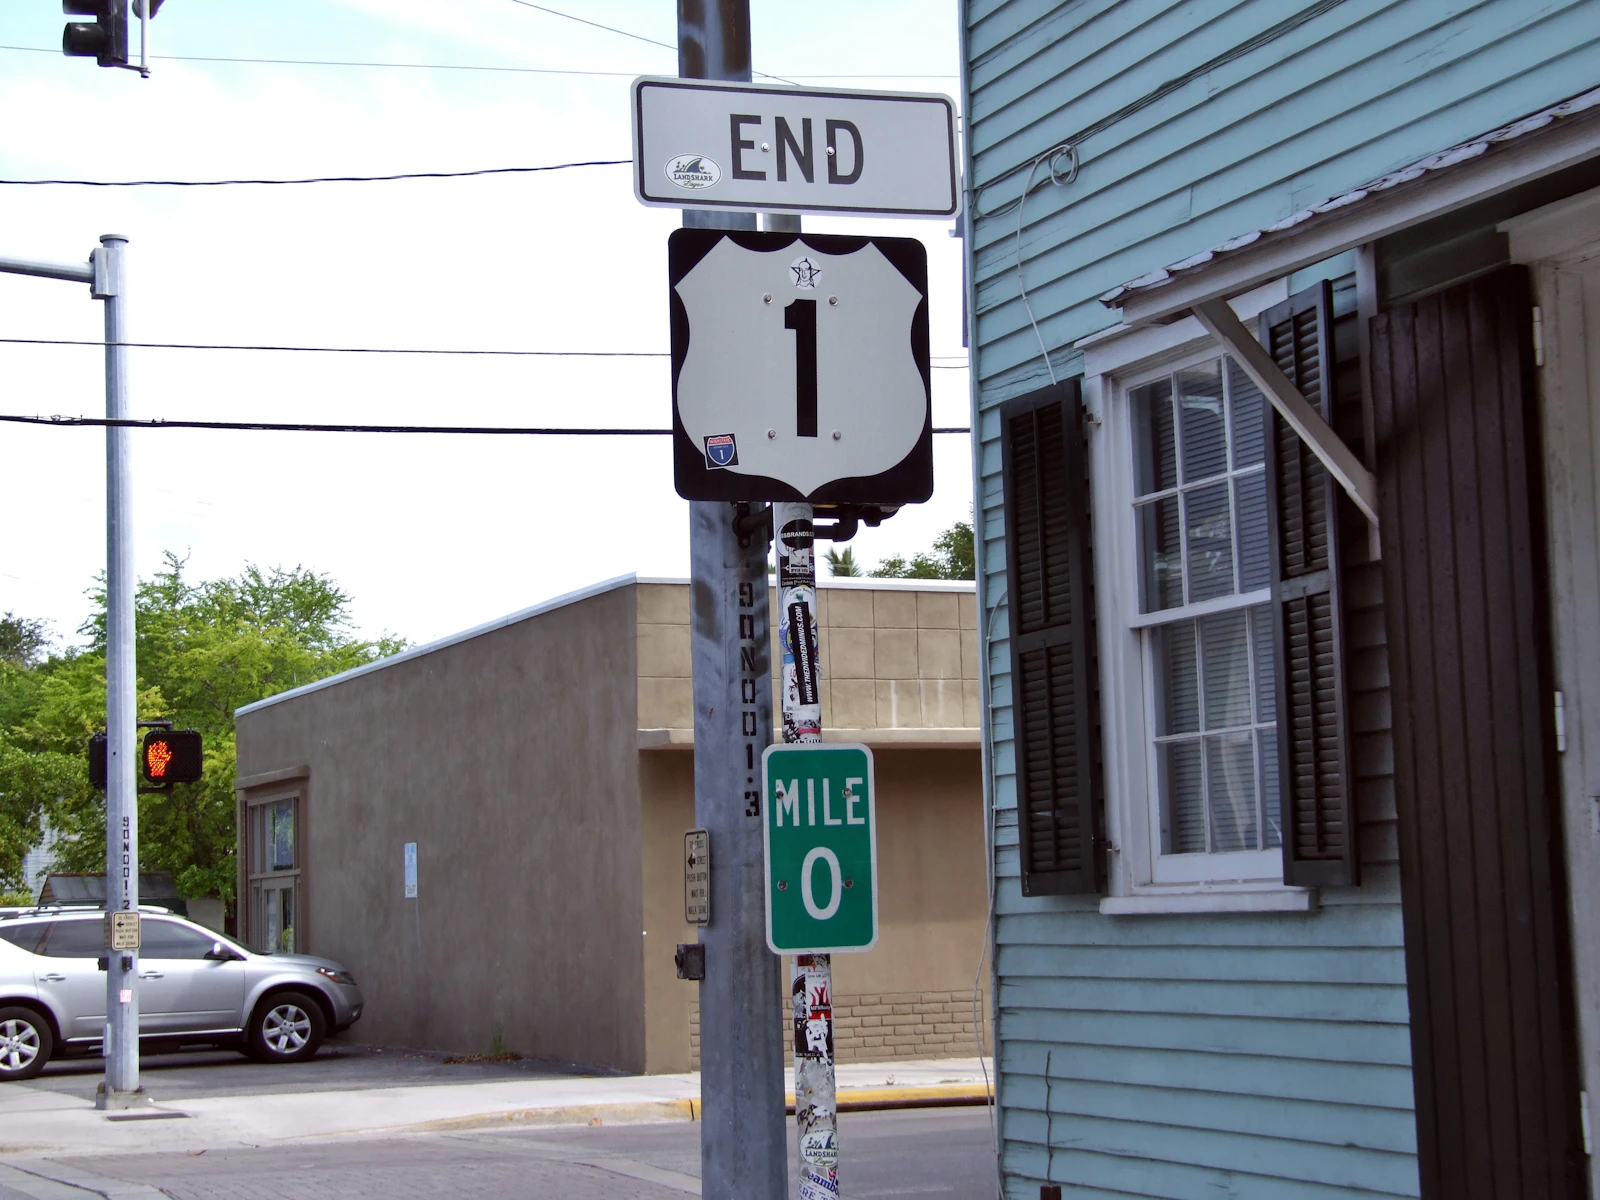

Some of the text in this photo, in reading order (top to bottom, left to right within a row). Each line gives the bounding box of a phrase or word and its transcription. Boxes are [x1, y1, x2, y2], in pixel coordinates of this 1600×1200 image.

[730, 113, 864, 185] END
[784, 298, 818, 437] 1
[719, 449, 724, 460] 1
[775, 777, 865, 827] MILE
[801, 846, 842, 920] 0
